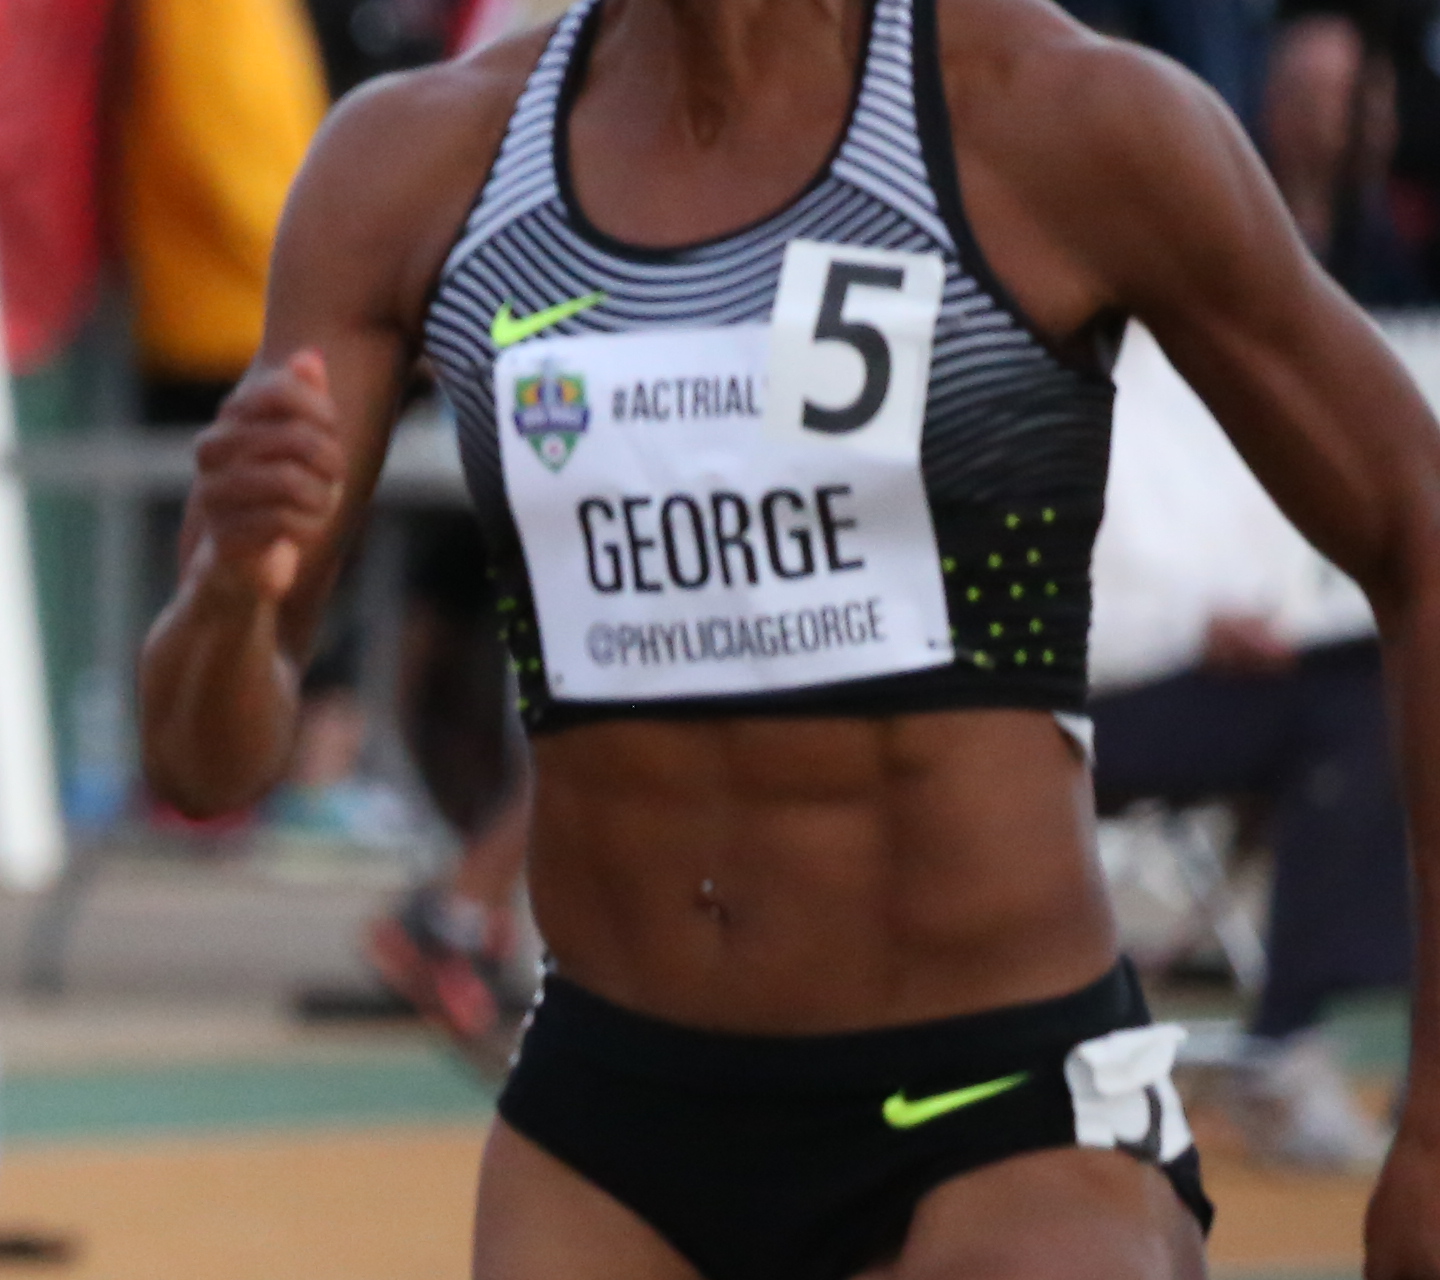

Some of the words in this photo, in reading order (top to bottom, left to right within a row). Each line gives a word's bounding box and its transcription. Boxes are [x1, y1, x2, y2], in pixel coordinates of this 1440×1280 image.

[612, 375, 763, 422] #ACTRIAL
[802, 260, 905, 434] 5
[579, 485, 864, 594] GEORGE
